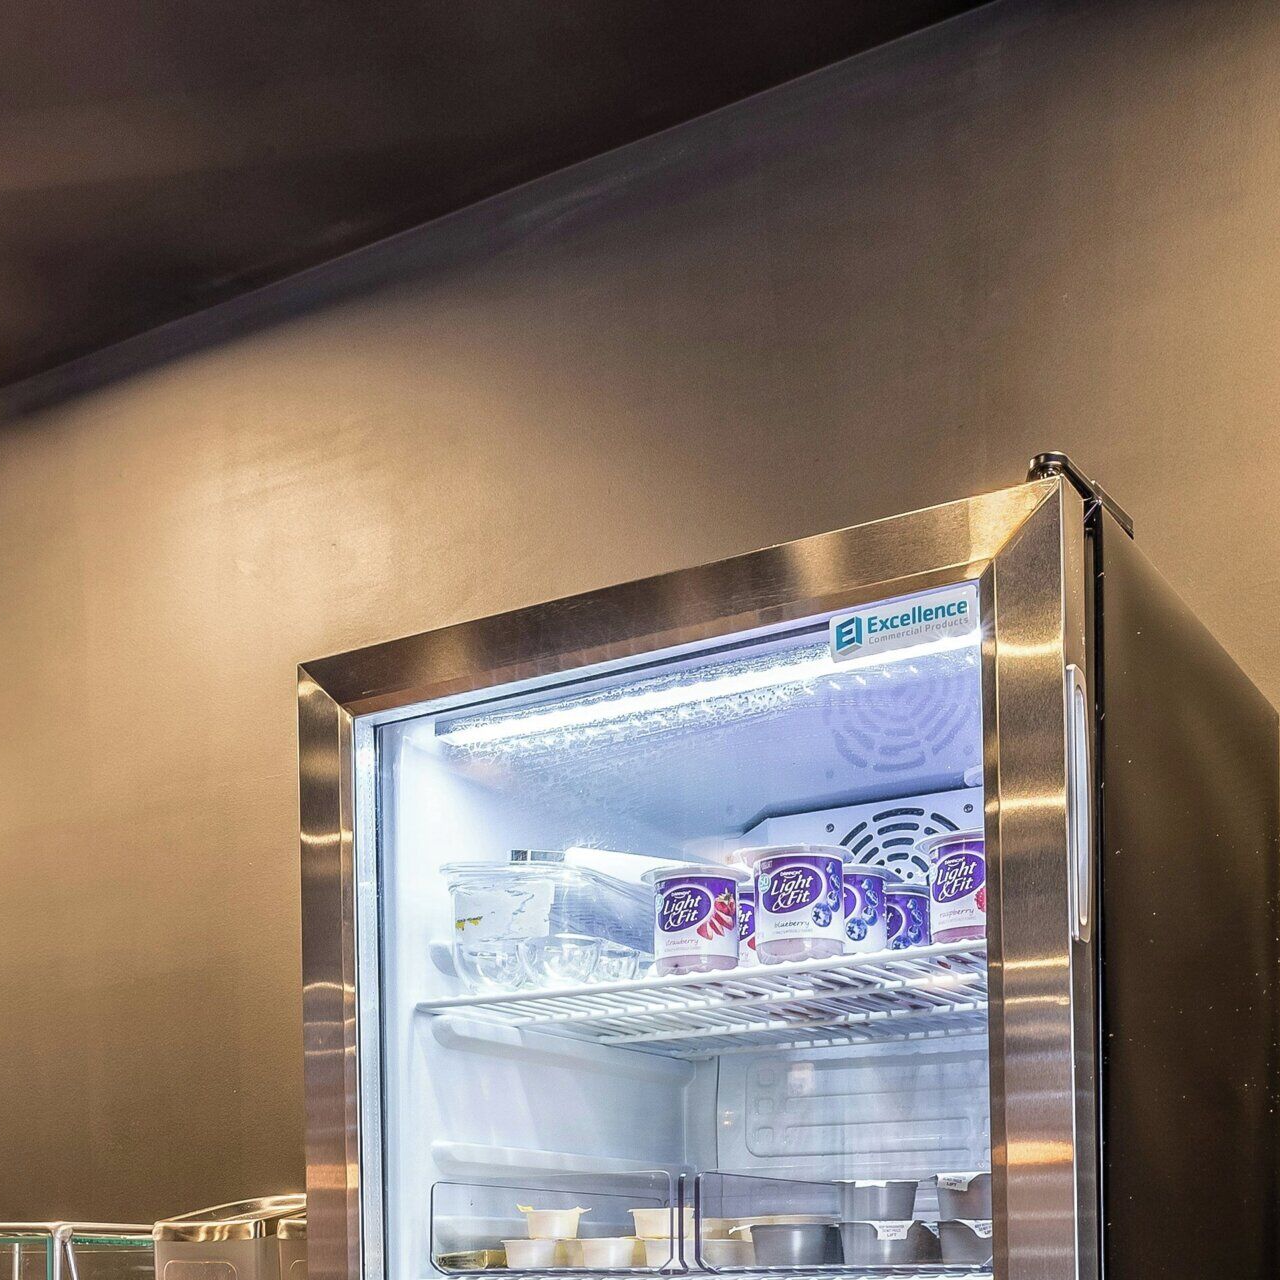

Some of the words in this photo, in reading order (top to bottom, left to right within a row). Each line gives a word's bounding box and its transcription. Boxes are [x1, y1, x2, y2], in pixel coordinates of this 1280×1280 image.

[868, 600, 967, 633] Excellence
[869, 626, 922, 645] Commercial
[925, 617, 968, 632] Products
[937, 861, 977, 885] Light
[771, 875, 813, 896] Light
[664, 895, 702, 915] Light
